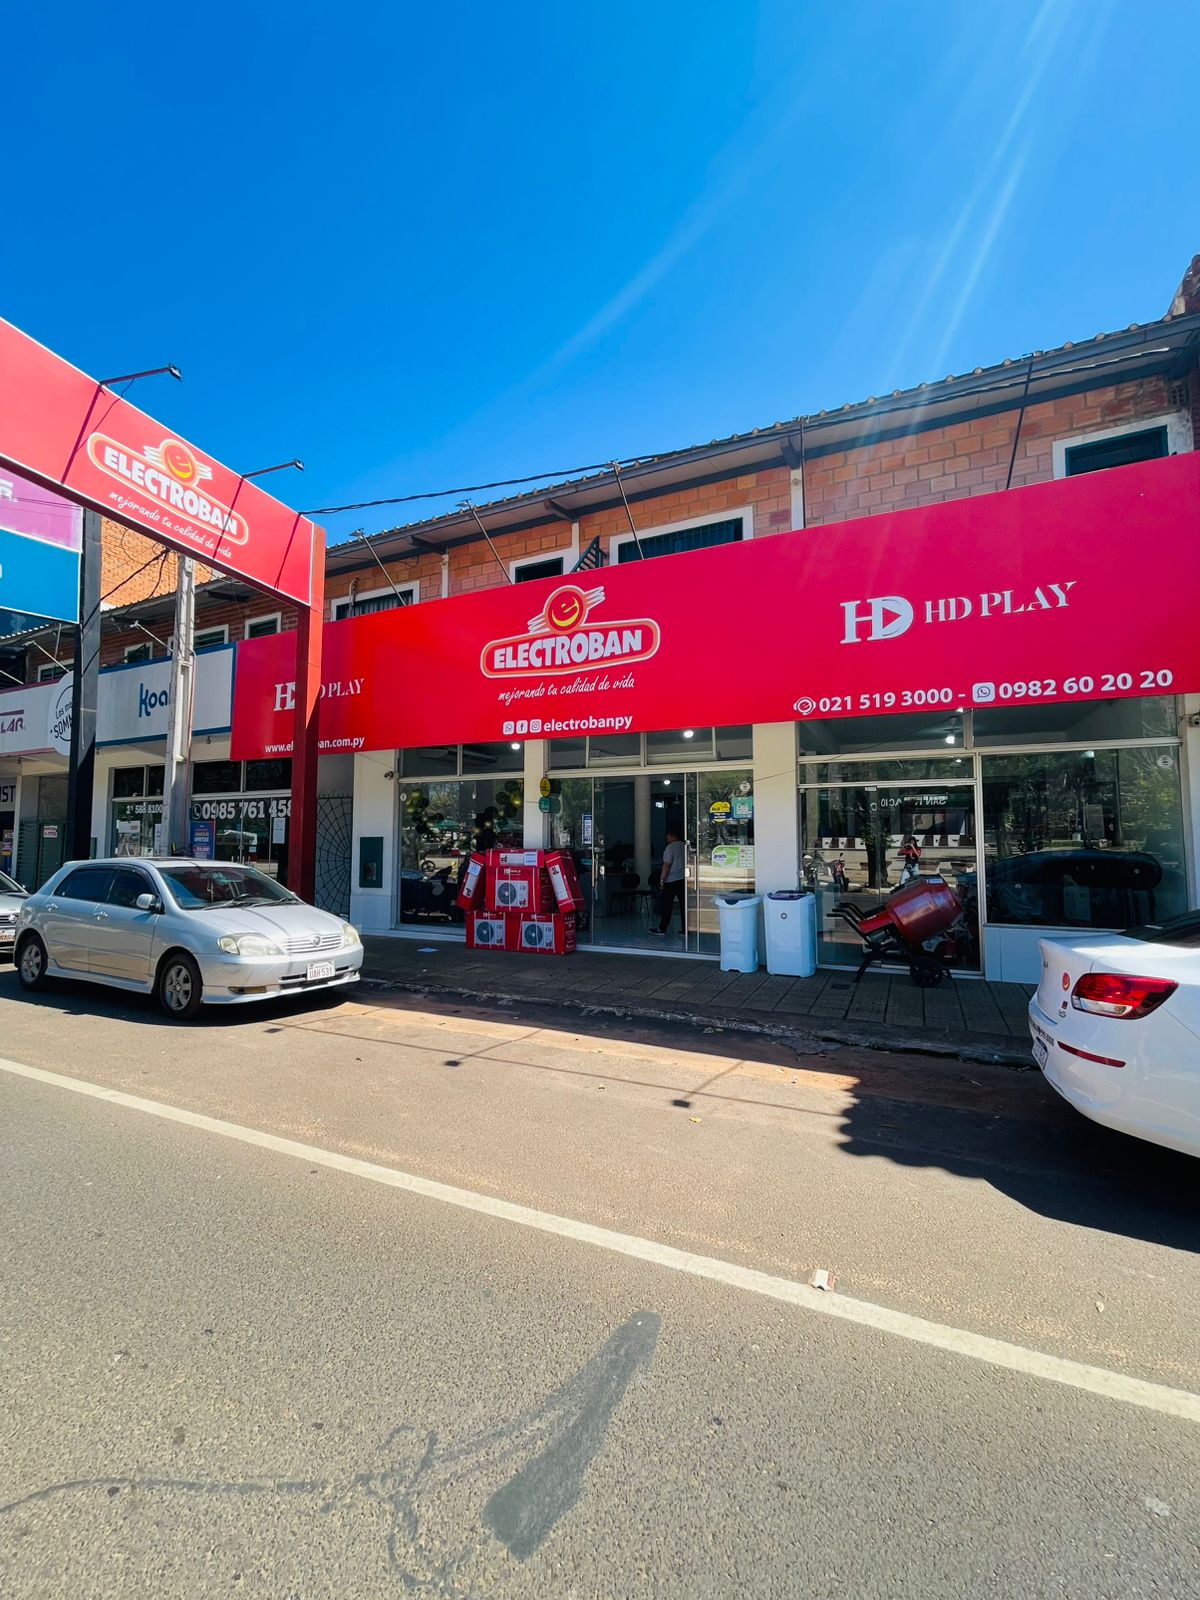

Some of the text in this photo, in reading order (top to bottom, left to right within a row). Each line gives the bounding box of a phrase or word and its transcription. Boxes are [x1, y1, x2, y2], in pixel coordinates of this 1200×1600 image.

[104, 445, 237, 536] ELECTROBAN
[109, 491, 160, 521] mejorando
[173, 524, 204, 545] calidad
[205, 538, 215, 550] de
[924, 581, 1077, 624] HD PLAY
[493, 630, 642, 669] ELECTROBAN
[138, 683, 168, 718] koa
[328, 678, 365, 697] PLAY
[498, 682, 545, 705] mejorando
[560, 677, 597, 694] calidad
[598, 677, 611, 691] de
[613, 673, 635, 689] vida
[819, 696, 852, 712] 021
[859, 693, 895, 710] 519
[900, 687, 953, 707] 3000
[999, 679, 1057, 699] 0982
[1062, 676, 1094, 694] 60
[1100, 673, 1133, 692] 20
[1139, 669, 1173, 689] 20
[543, 715, 633, 732] electrobanpy
[202, 802, 236, 820] 0985
[239, 801, 265, 818] 761
